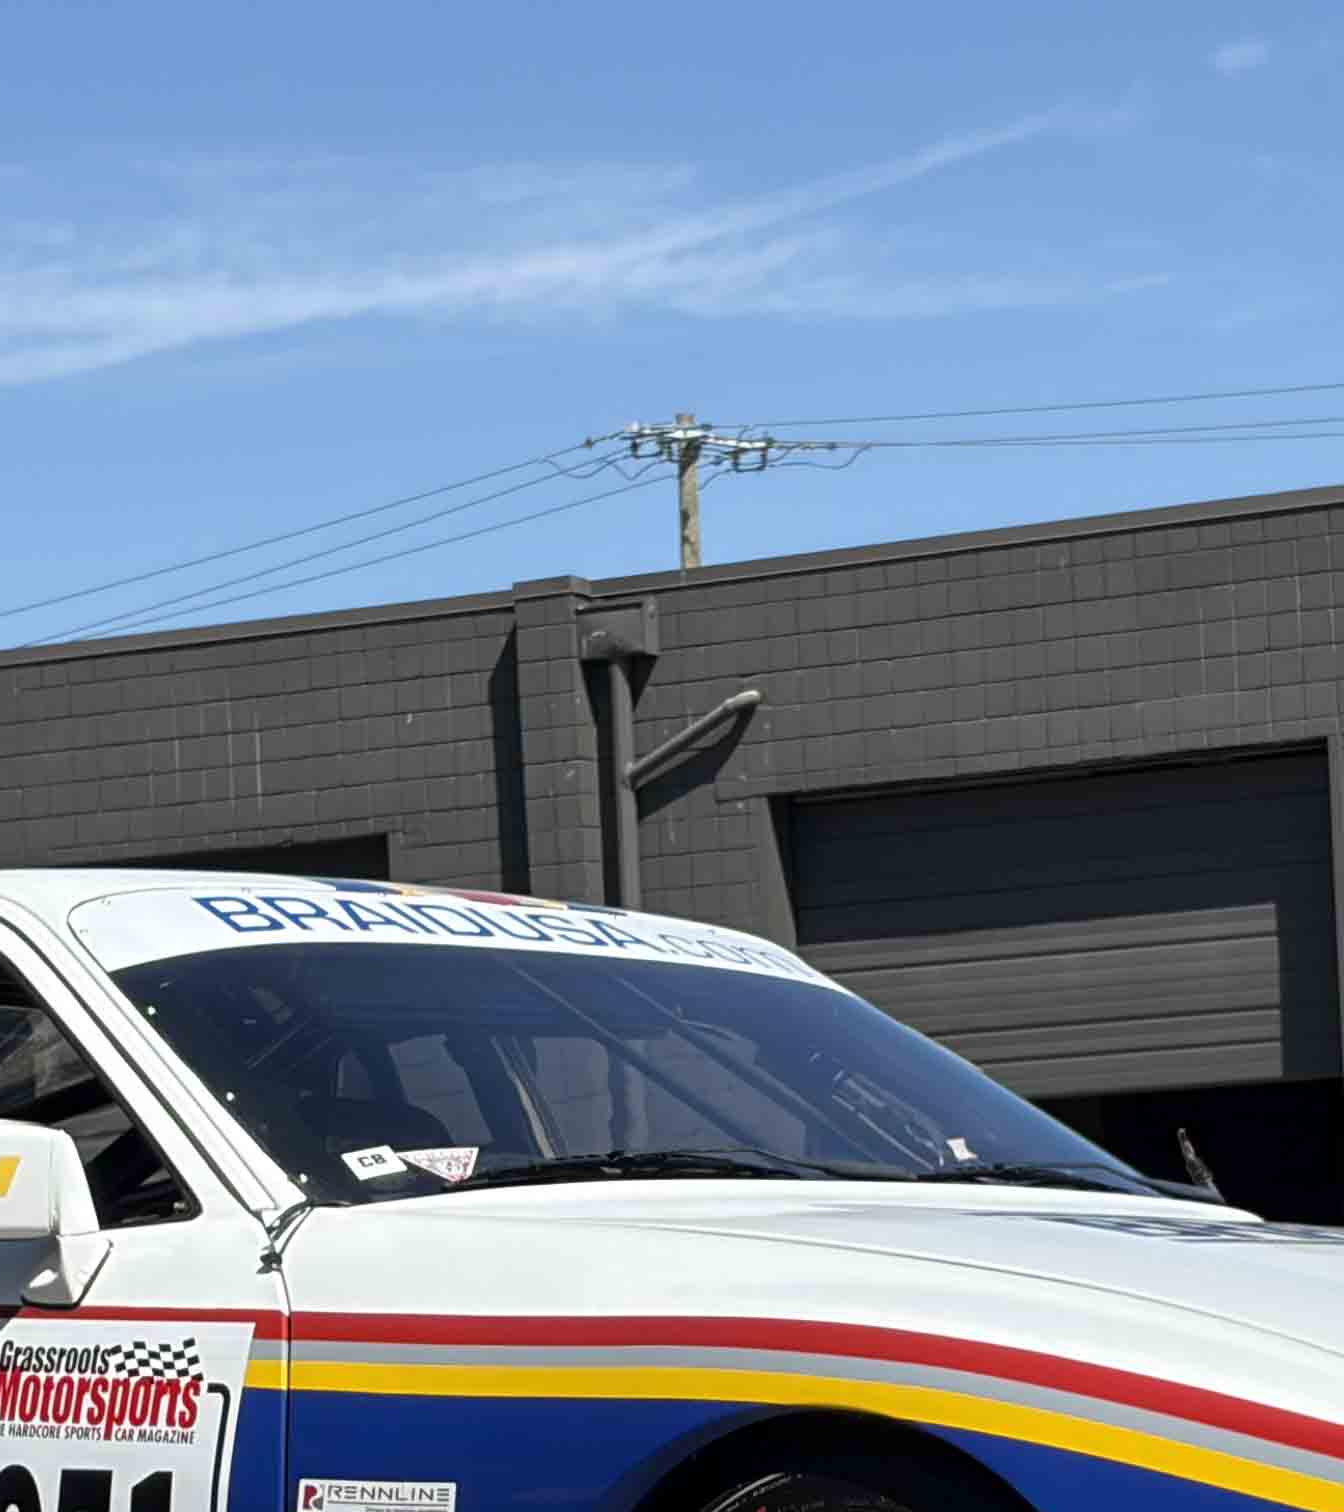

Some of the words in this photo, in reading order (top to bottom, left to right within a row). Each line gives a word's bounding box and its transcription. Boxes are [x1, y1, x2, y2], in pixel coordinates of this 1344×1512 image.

[8, 1424, 62, 1439] HARDCORE
[64, 1426, 102, 1441] SPORTS
[114, 1428, 135, 1442] CAR
[137, 1429, 196, 1445] MAGAZINE
[327, 1485, 450, 1502] RENNLINE
